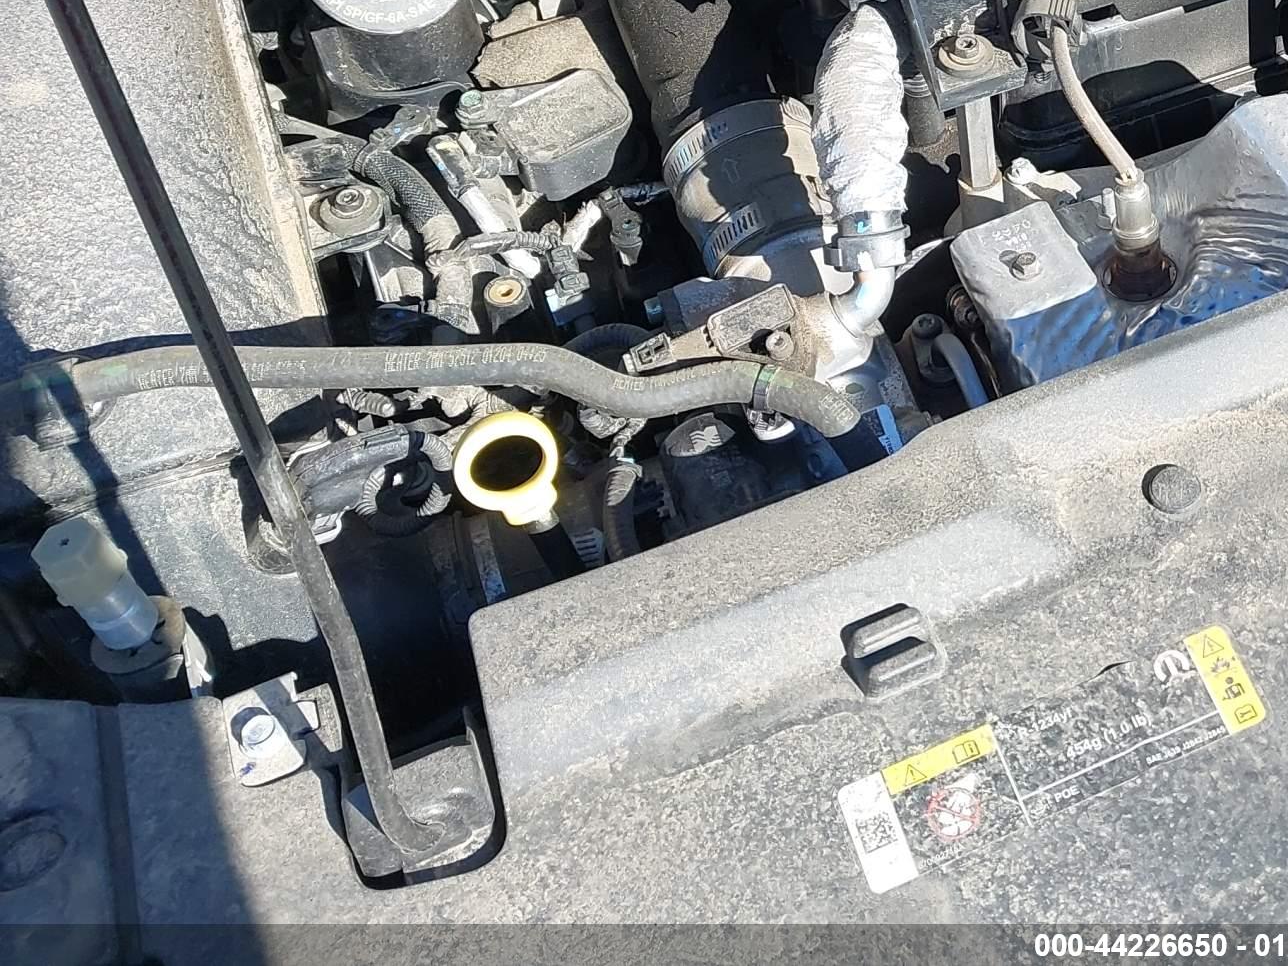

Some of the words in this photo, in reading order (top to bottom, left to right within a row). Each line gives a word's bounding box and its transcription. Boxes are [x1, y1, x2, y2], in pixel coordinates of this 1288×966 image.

[384, 351, 420, 372] HEATER
[1018, 710, 1072, 739] R-1234yf
[1066, 737, 1102, 759] 454g
[1103, 721, 1130, 744] (1.0
[1130, 712, 1152, 731] lb)
[1146, 754, 1162, 766] SAE
[1053, 786, 1081, 804] POE
